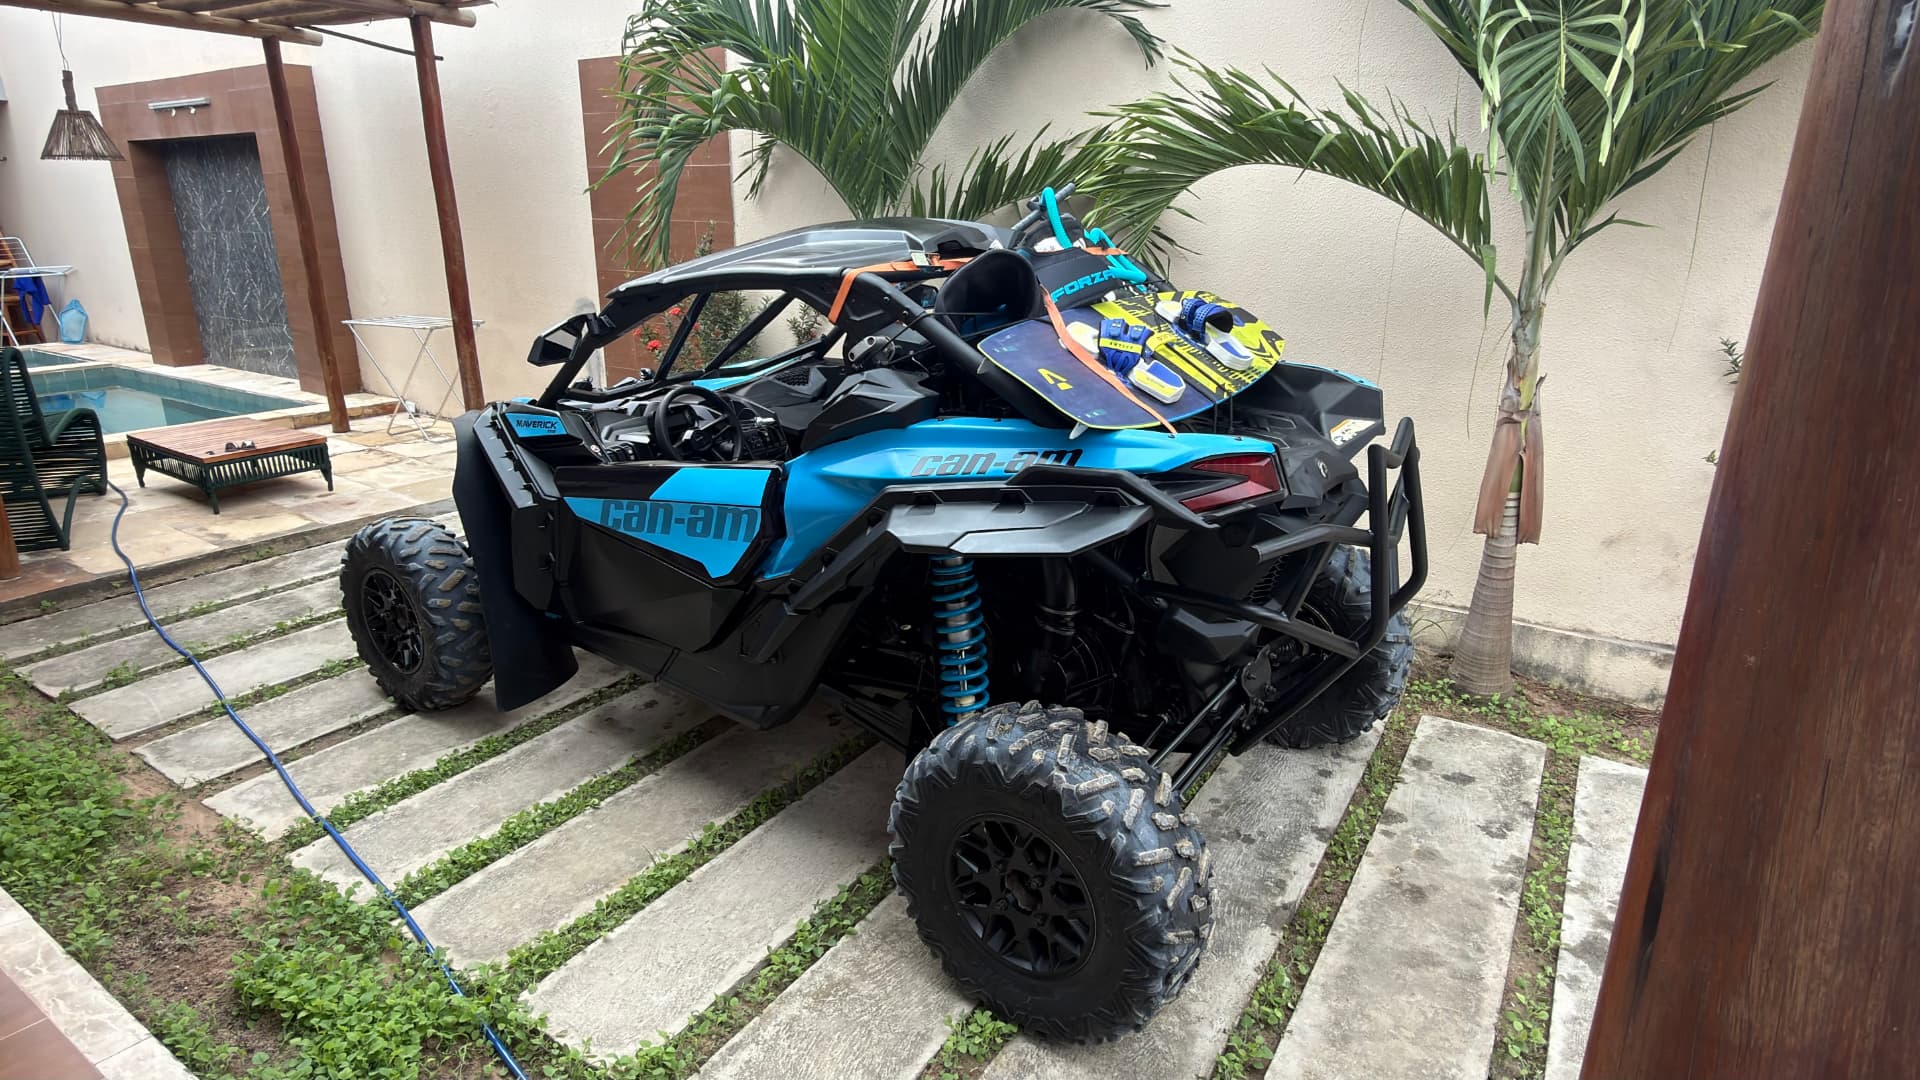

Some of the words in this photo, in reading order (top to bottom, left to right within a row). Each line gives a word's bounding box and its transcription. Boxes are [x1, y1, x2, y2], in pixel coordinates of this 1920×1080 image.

[1050, 269, 1117, 304] FORZA
[516, 419, 558, 429] MAVERICK
[912, 448, 1083, 477] can-am
[600, 500, 759, 543] can-am
